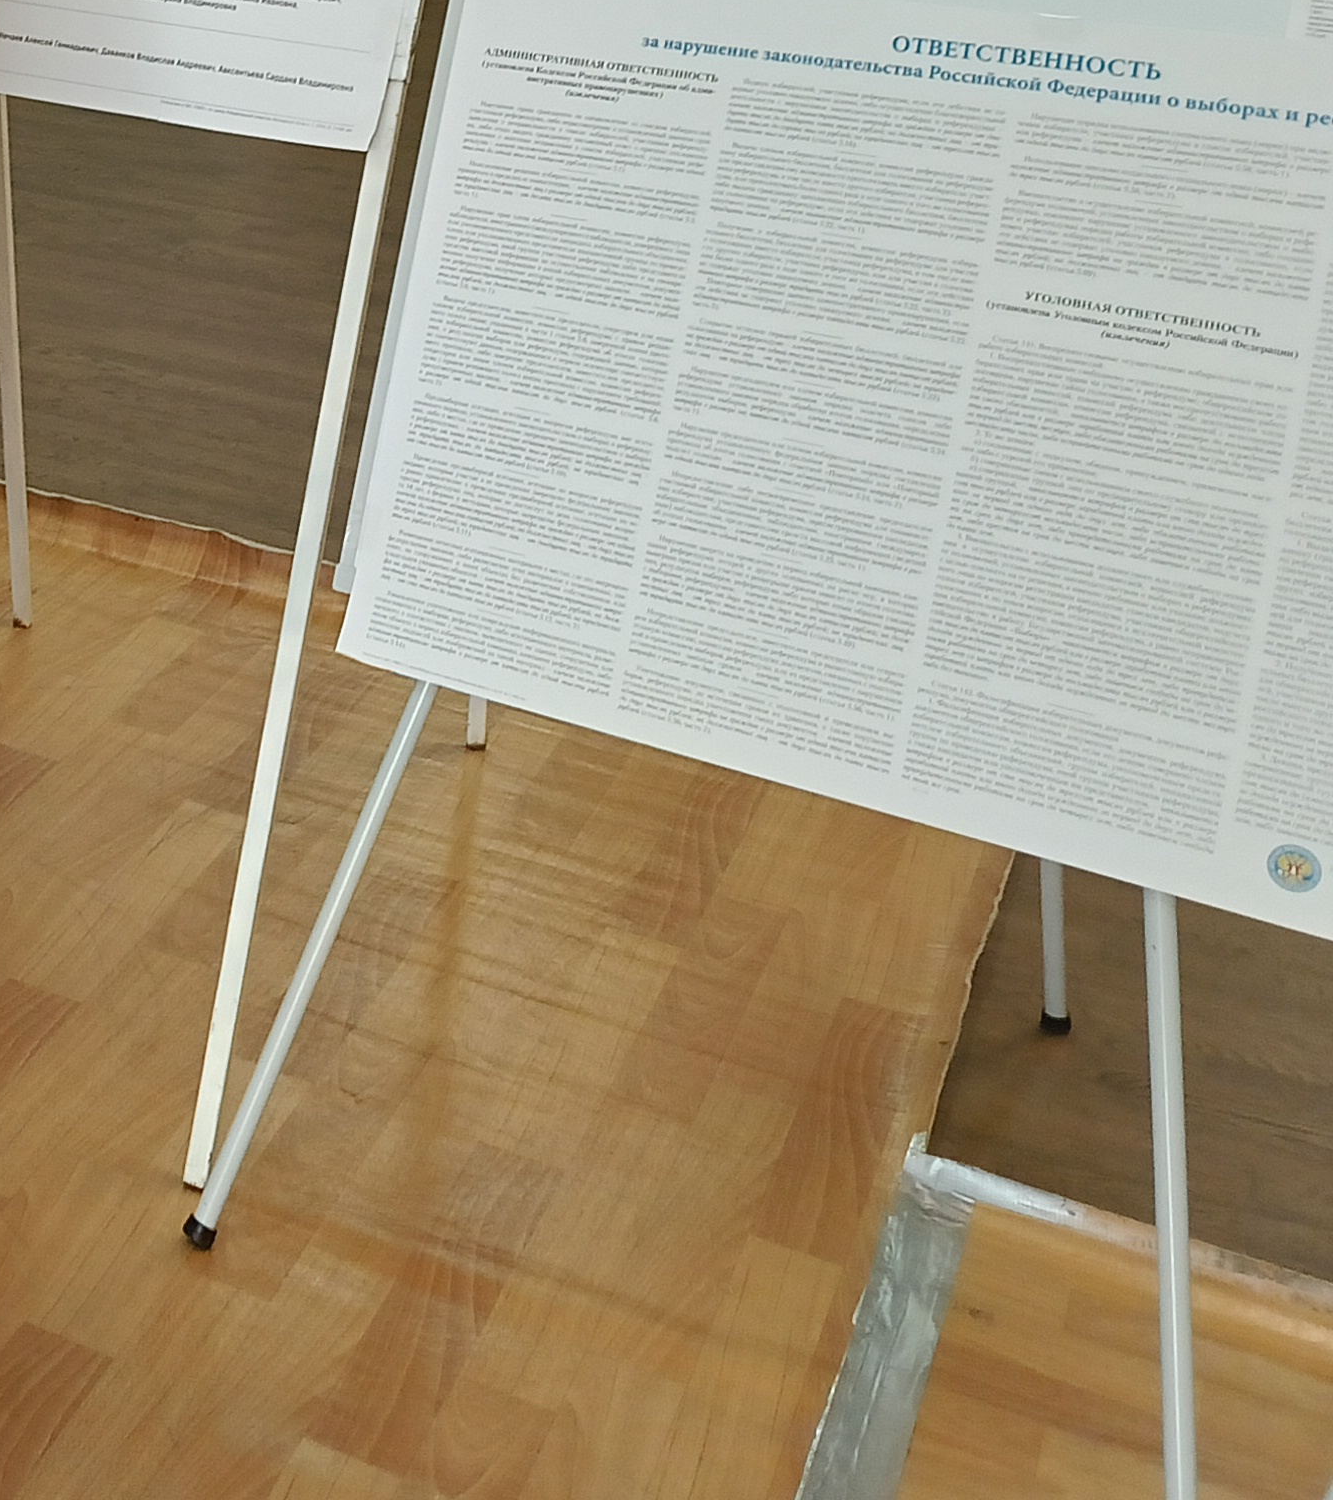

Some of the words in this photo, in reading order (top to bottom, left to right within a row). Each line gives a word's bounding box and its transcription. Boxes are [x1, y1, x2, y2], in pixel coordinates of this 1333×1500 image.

[484, 47, 605, 70] АДМИНИСТРАТИВНАЯ
[607, 60, 719, 84] ОТВЕТСТВЕННОСТЬ
[891, 35, 1162, 80] ОТВЕТСТВЕННОСТЬ
[641, 37, 658, 48] за
[664, 38, 759, 61] нарушение
[762, 50, 923, 79] законодательства
[930, 65, 1041, 92] Российской
[1047, 78, 1161, 106] Федерации
[1167, 97, 1180, 108] о
[1185, 97, 1279, 121] выборах
[1285, 110, 1300, 121] и
[1305, 112, 1333, 128] ре
[1025, 290, 1112, 314] УГОЛОВНАЯ
[1114, 305, 1261, 338] ОТВЕТСТВЕННОСТЬ
